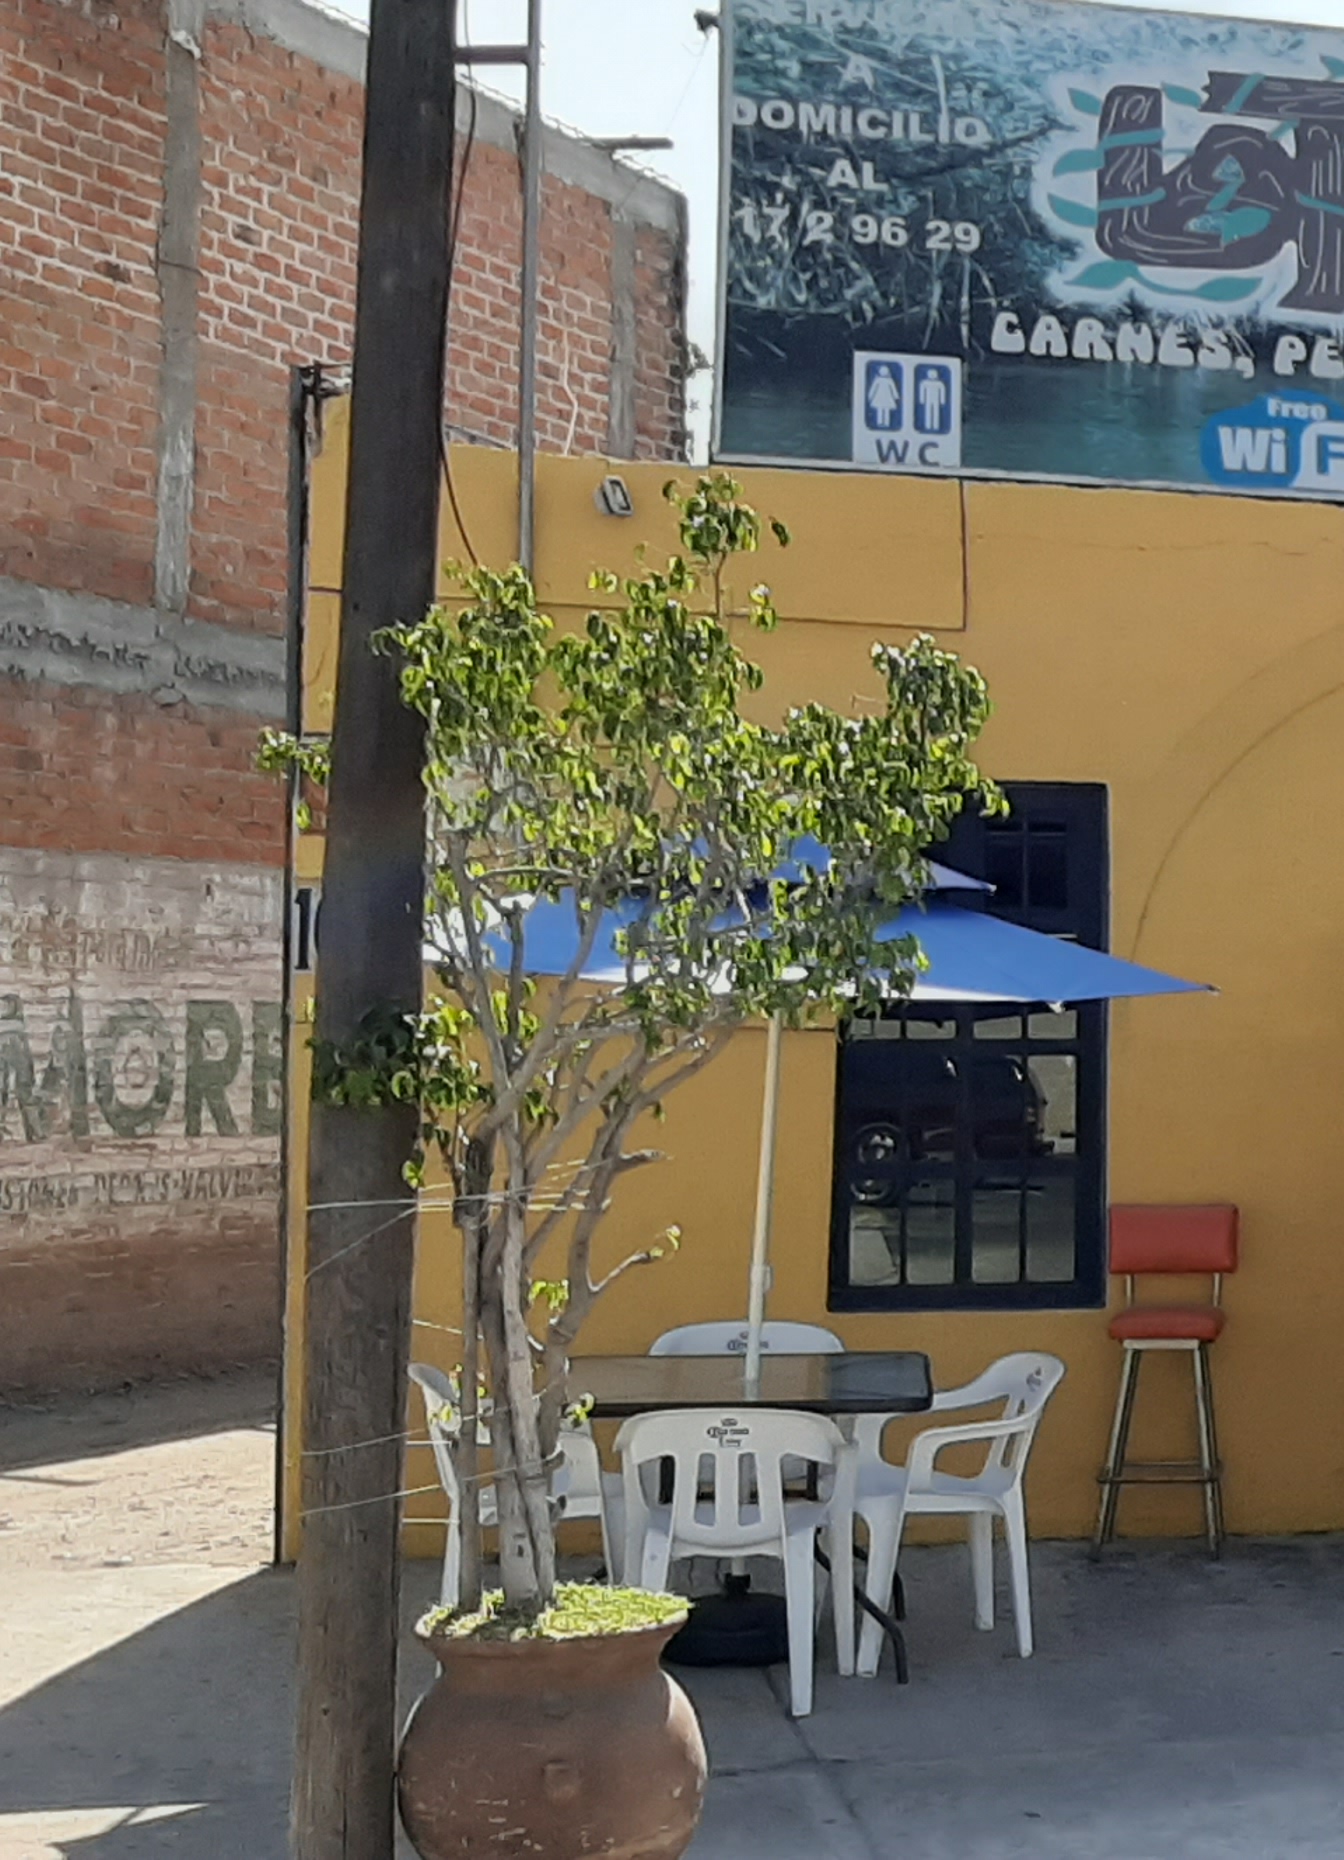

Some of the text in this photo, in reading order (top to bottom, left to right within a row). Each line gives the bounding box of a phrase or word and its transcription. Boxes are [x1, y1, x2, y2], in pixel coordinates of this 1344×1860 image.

[733, 97, 992, 148] DOMICILIO
[826, 158, 889, 190] AL
[802, 209, 835, 247] 2
[851, 214, 909, 247] 96
[924, 219, 982, 251] 29
[990, 311, 1254, 378] CARNES,
[1267, 398, 1327, 420] Free
[876, 438, 940, 467] WC
